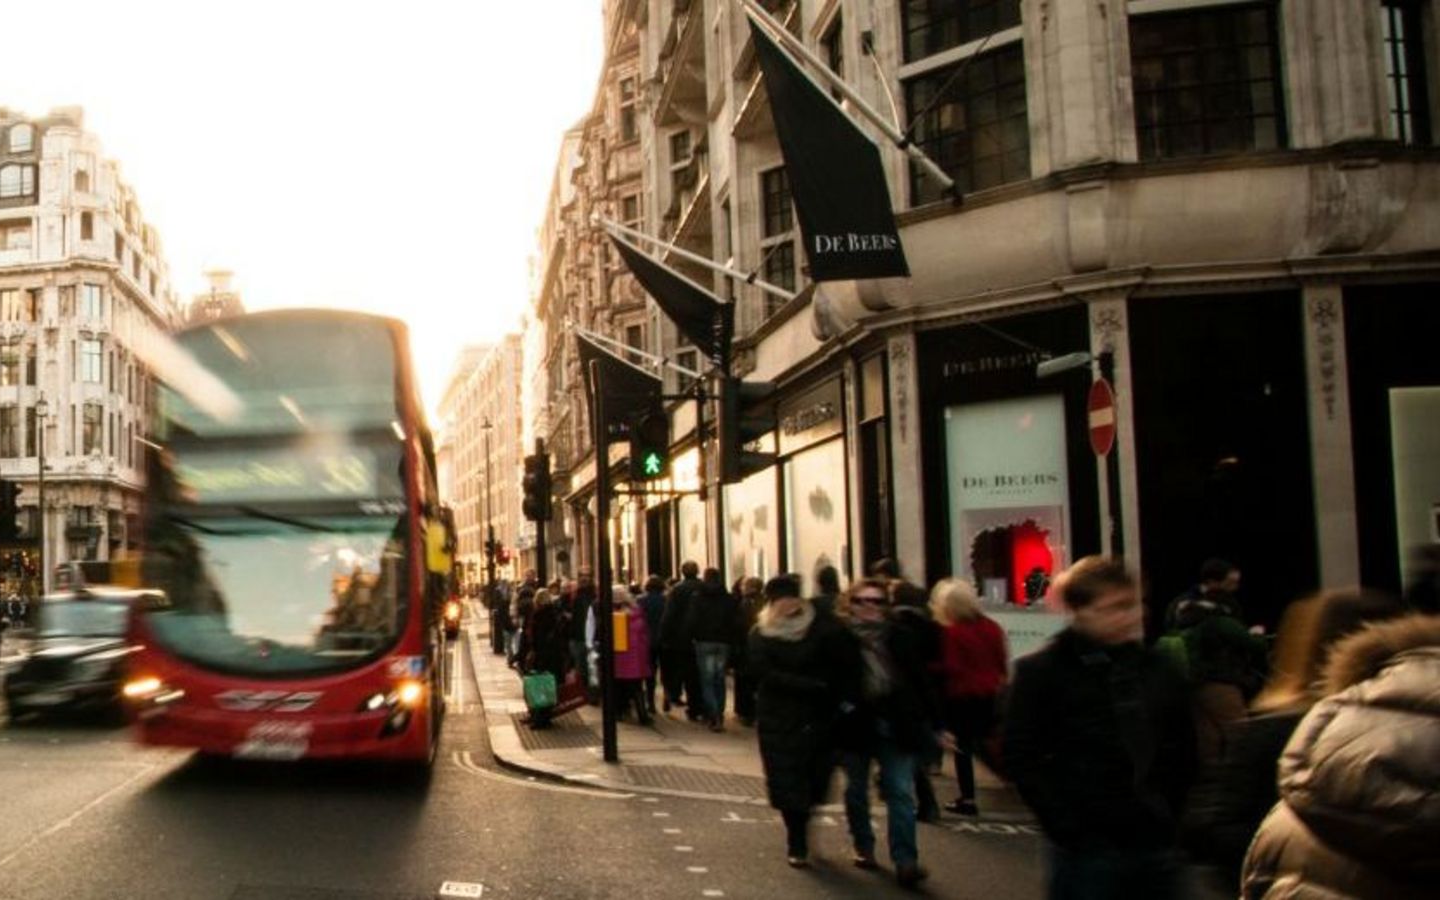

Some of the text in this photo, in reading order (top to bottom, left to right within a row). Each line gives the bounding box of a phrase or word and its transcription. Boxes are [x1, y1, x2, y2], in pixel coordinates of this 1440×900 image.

[815, 232, 897, 253] DE BEERS
[963, 472, 1058, 490] DE BEERS
